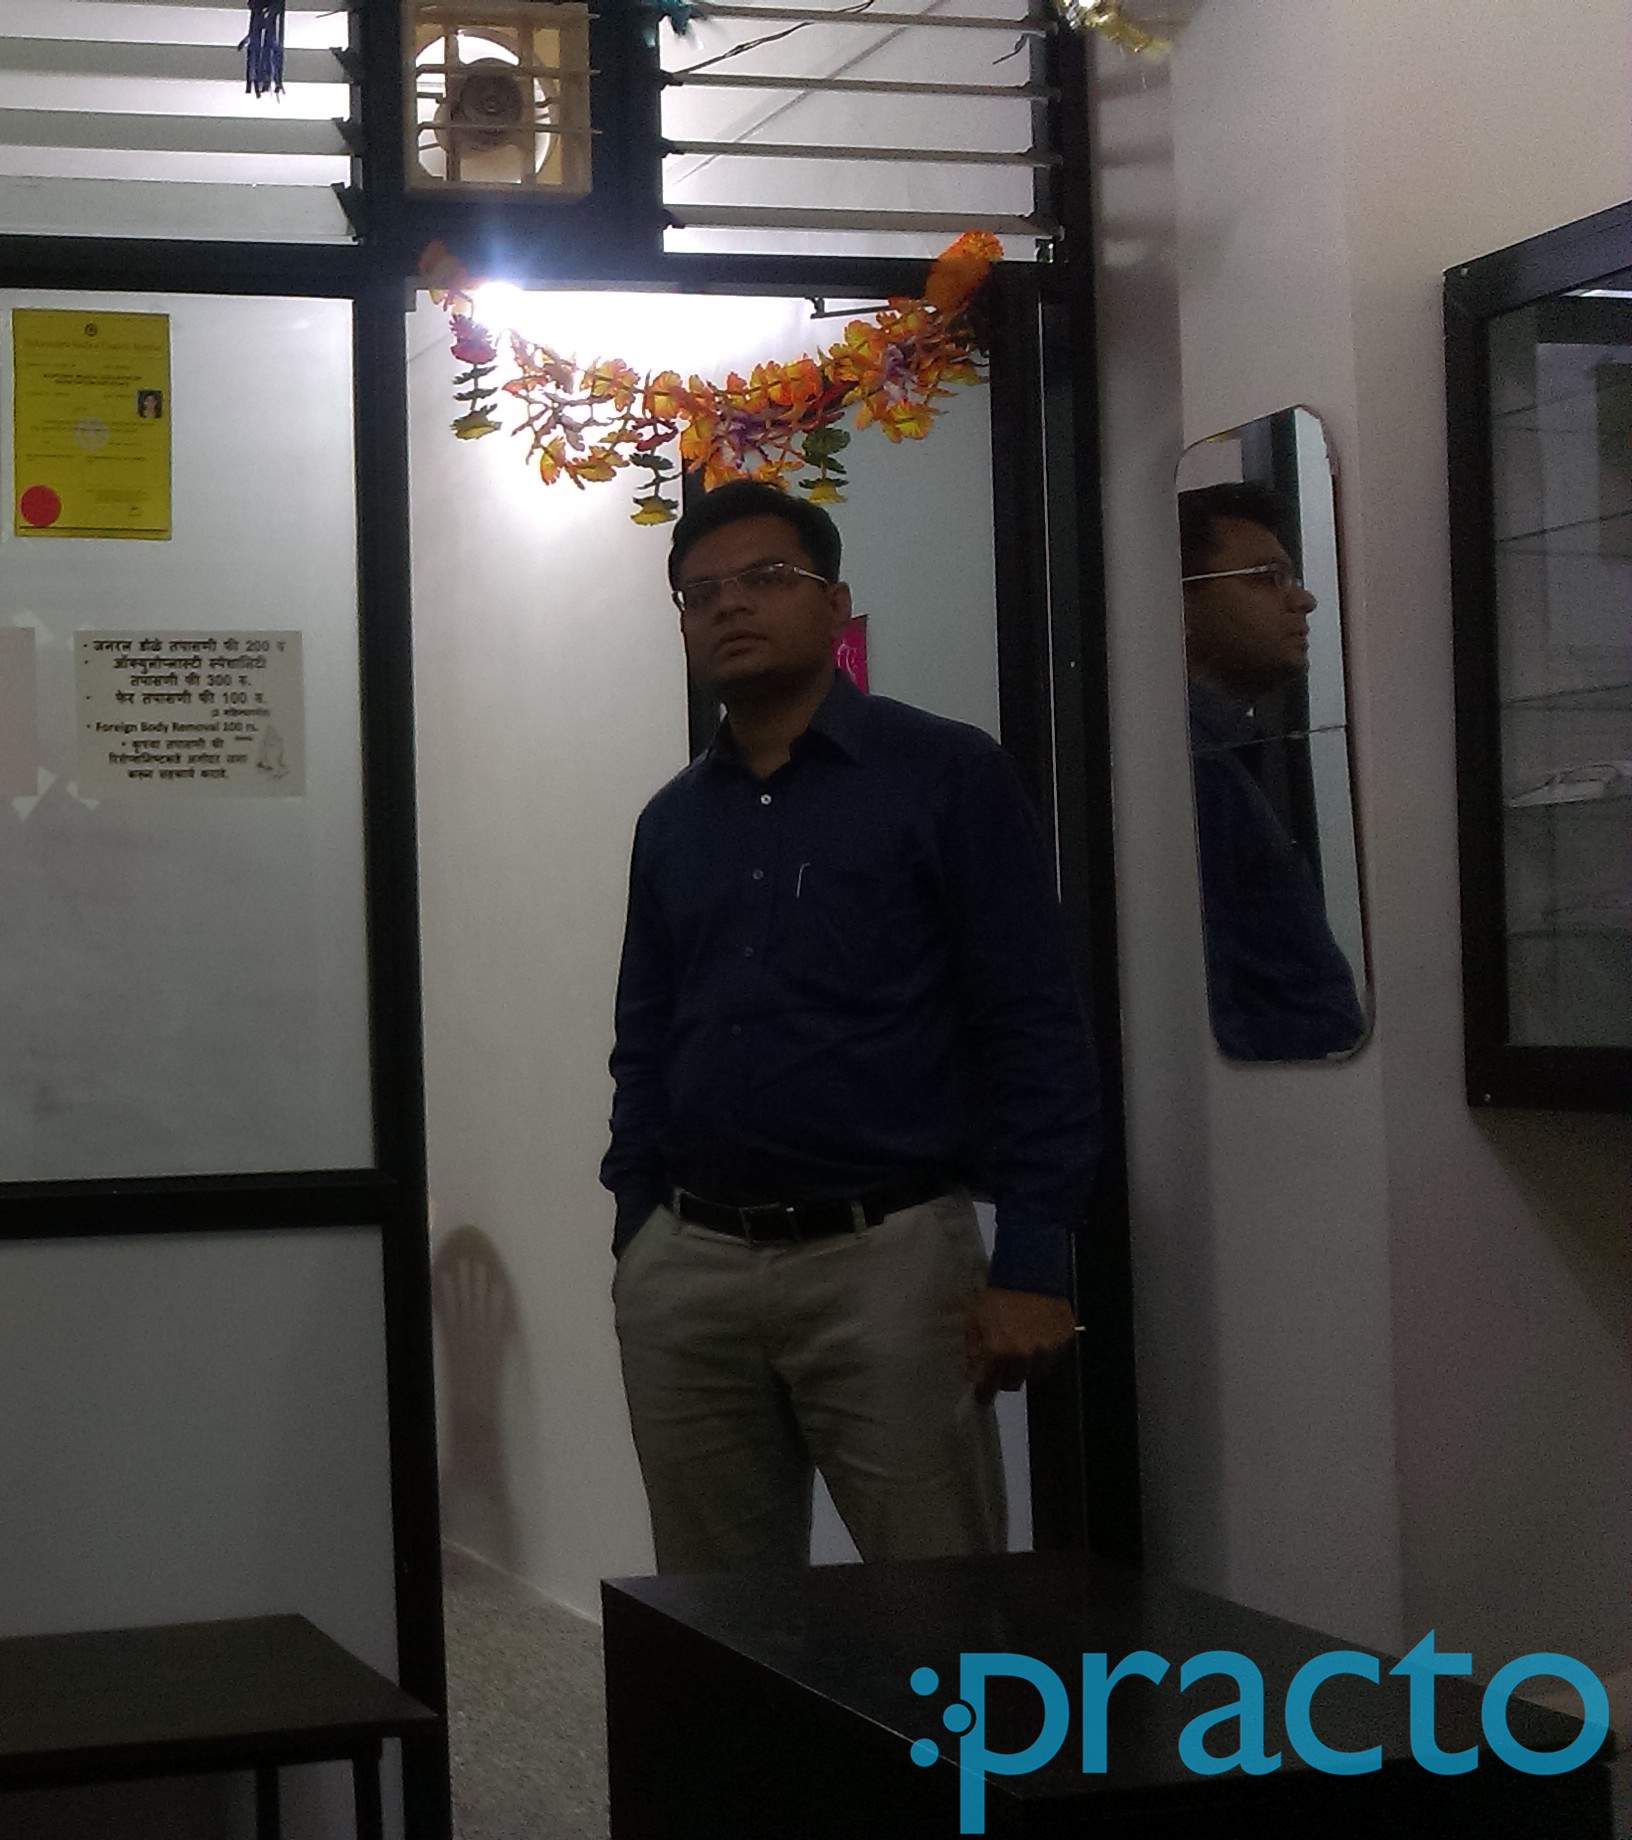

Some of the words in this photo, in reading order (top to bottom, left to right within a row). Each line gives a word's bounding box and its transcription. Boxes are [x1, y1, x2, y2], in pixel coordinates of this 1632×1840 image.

[245, 640, 270, 652] 200
[207, 674, 233, 686] 300
[222, 692, 247, 704] 100
[95, 721, 138, 734] Foreign
[141, 721, 169, 734] Body
[172, 721, 219, 732] Removal
